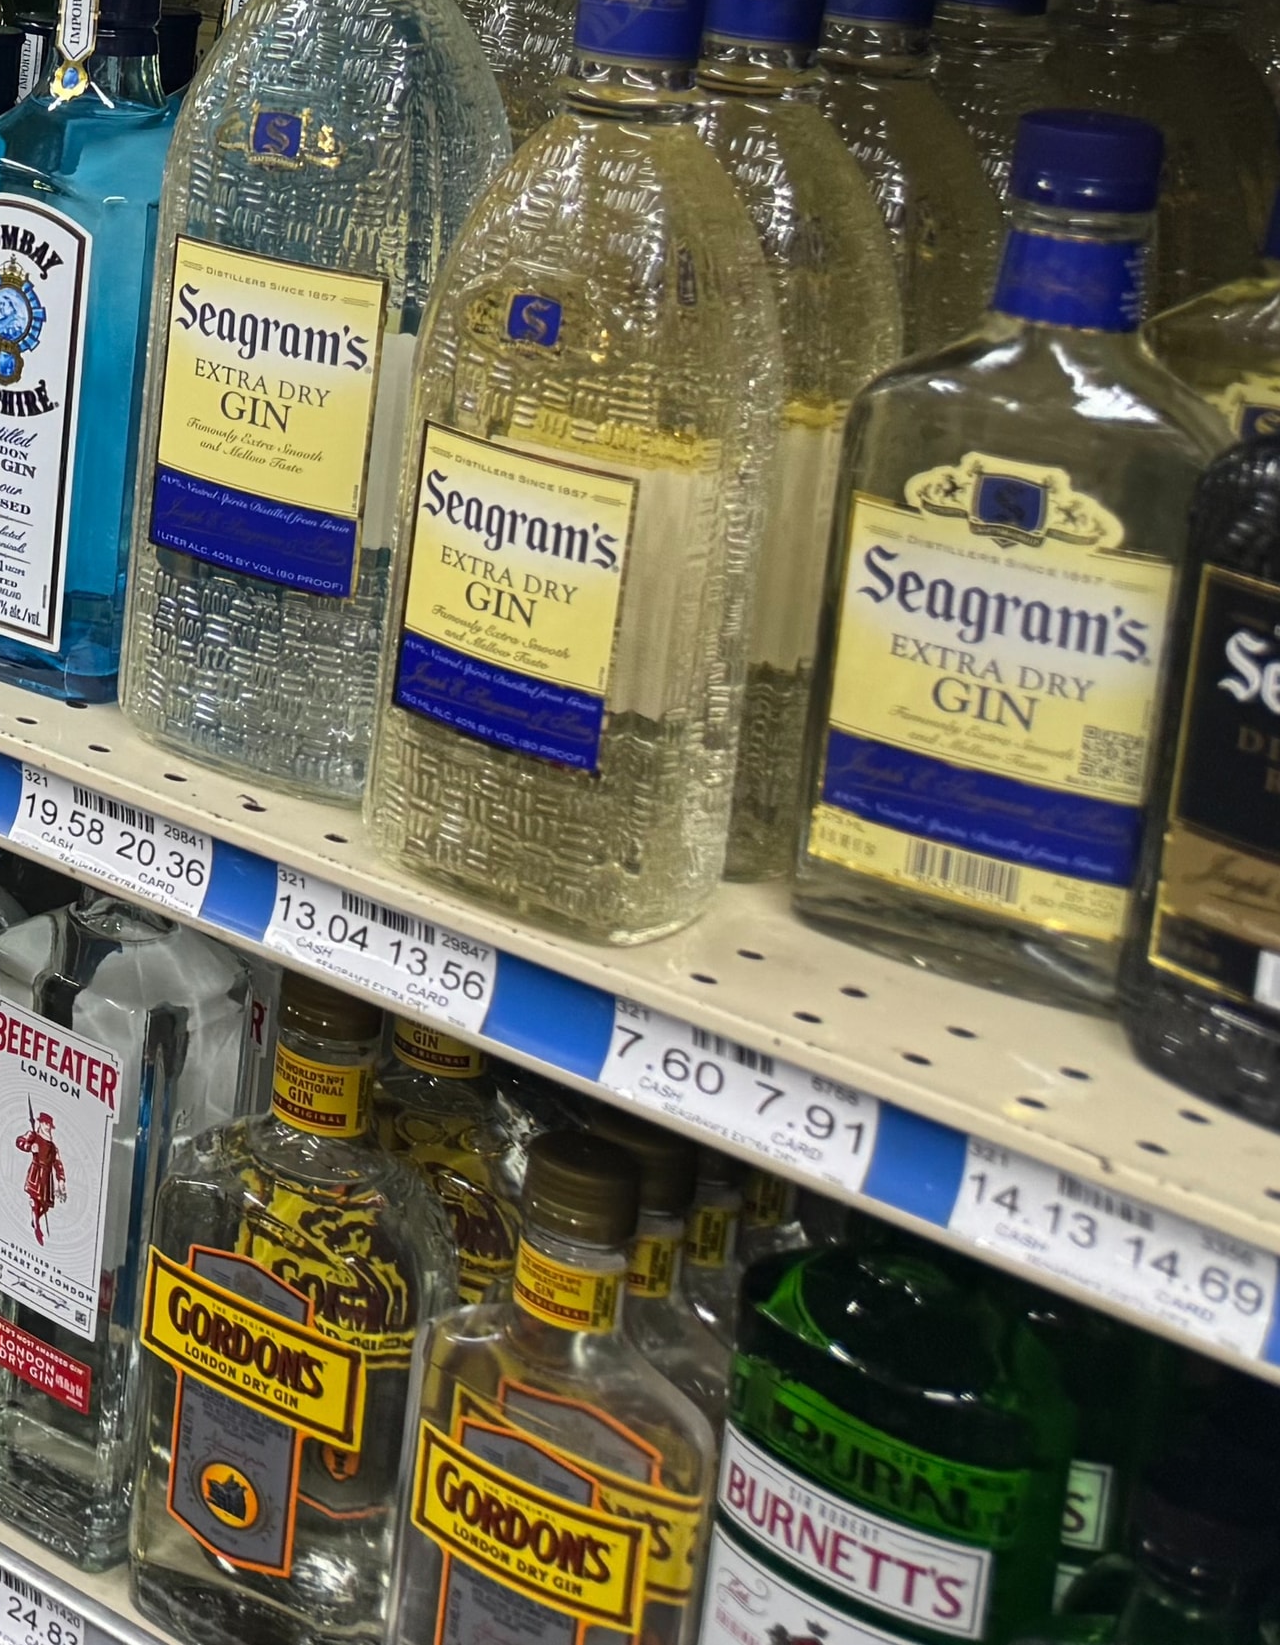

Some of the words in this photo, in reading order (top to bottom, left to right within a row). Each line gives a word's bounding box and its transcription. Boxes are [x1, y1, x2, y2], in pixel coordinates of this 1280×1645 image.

[175, 282, 369, 372] Seagram's
[194, 358, 266, 396] EXTRA
[278, 379, 331, 409] DRY
[220, 390, 292, 433] GIN
[420, 468, 619, 570] Seagram's
[440, 545, 509, 588] EXTRA
[523, 576, 579, 605] DRY
[464, 581, 537, 628] GIN
[858, 545, 1150, 663] Seagram's
[890, 634, 1001, 685] EXTRA
[1019, 666, 1095, 702] DRY
[932, 676, 1039, 732] GIN
[25, 792, 104, 846] 19.58
[116, 831, 205, 887] 20.36
[279, 894, 369, 952] 13.04
[389, 939, 486, 1001] 13.56
[614, 1024, 725, 1097] 7.60
[753, 1081, 867, 1154] 7.91
[968, 1173, 1098, 1250] 14.13
[1125, 1236, 1265, 1317] 14.69
[167, 1284, 324, 1399] GORDON'S
[435, 1460, 612, 1585] GORDON'S
[452, 1521, 511, 1564] LONDON
[515, 1554, 548, 1581] DRY
[552, 1571, 583, 1598] GIN
[728, 1459, 965, 1620] BURNETT'S
